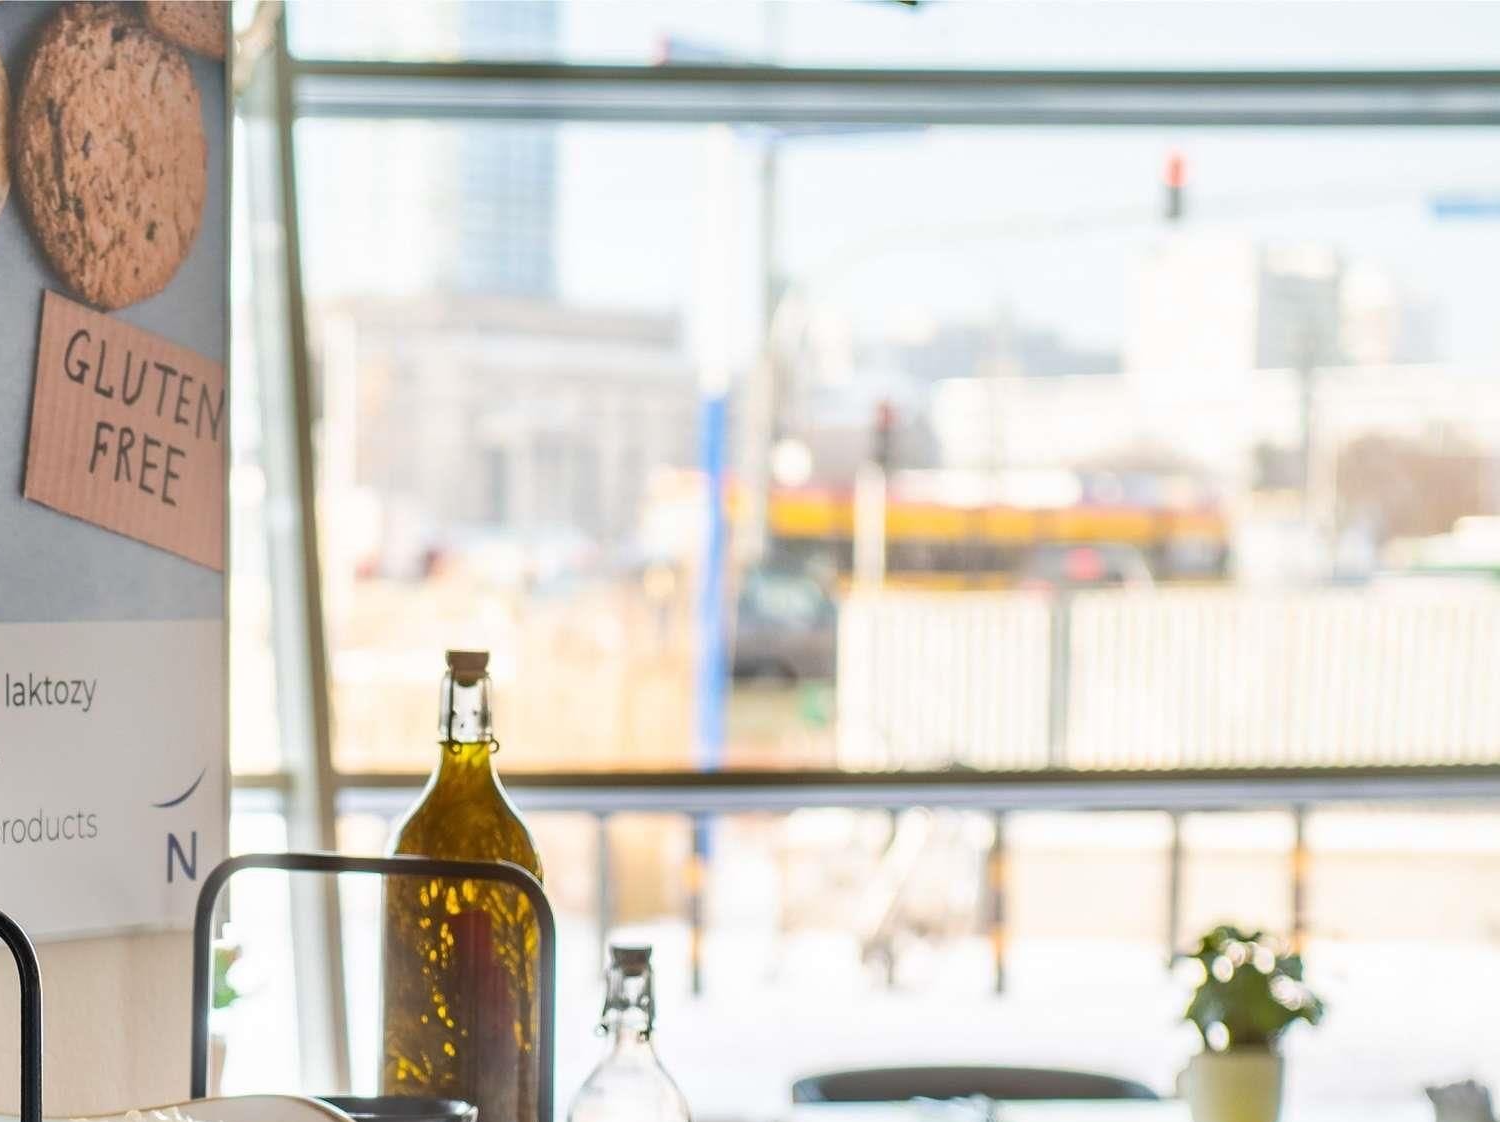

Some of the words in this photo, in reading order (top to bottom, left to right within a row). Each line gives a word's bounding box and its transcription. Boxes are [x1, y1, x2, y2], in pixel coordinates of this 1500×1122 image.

[63, 328, 226, 442] GLUTEN
[88, 420, 186, 507] FREE
[5, 672, 98, 713] laktozy
[166, 831, 198, 884] N
